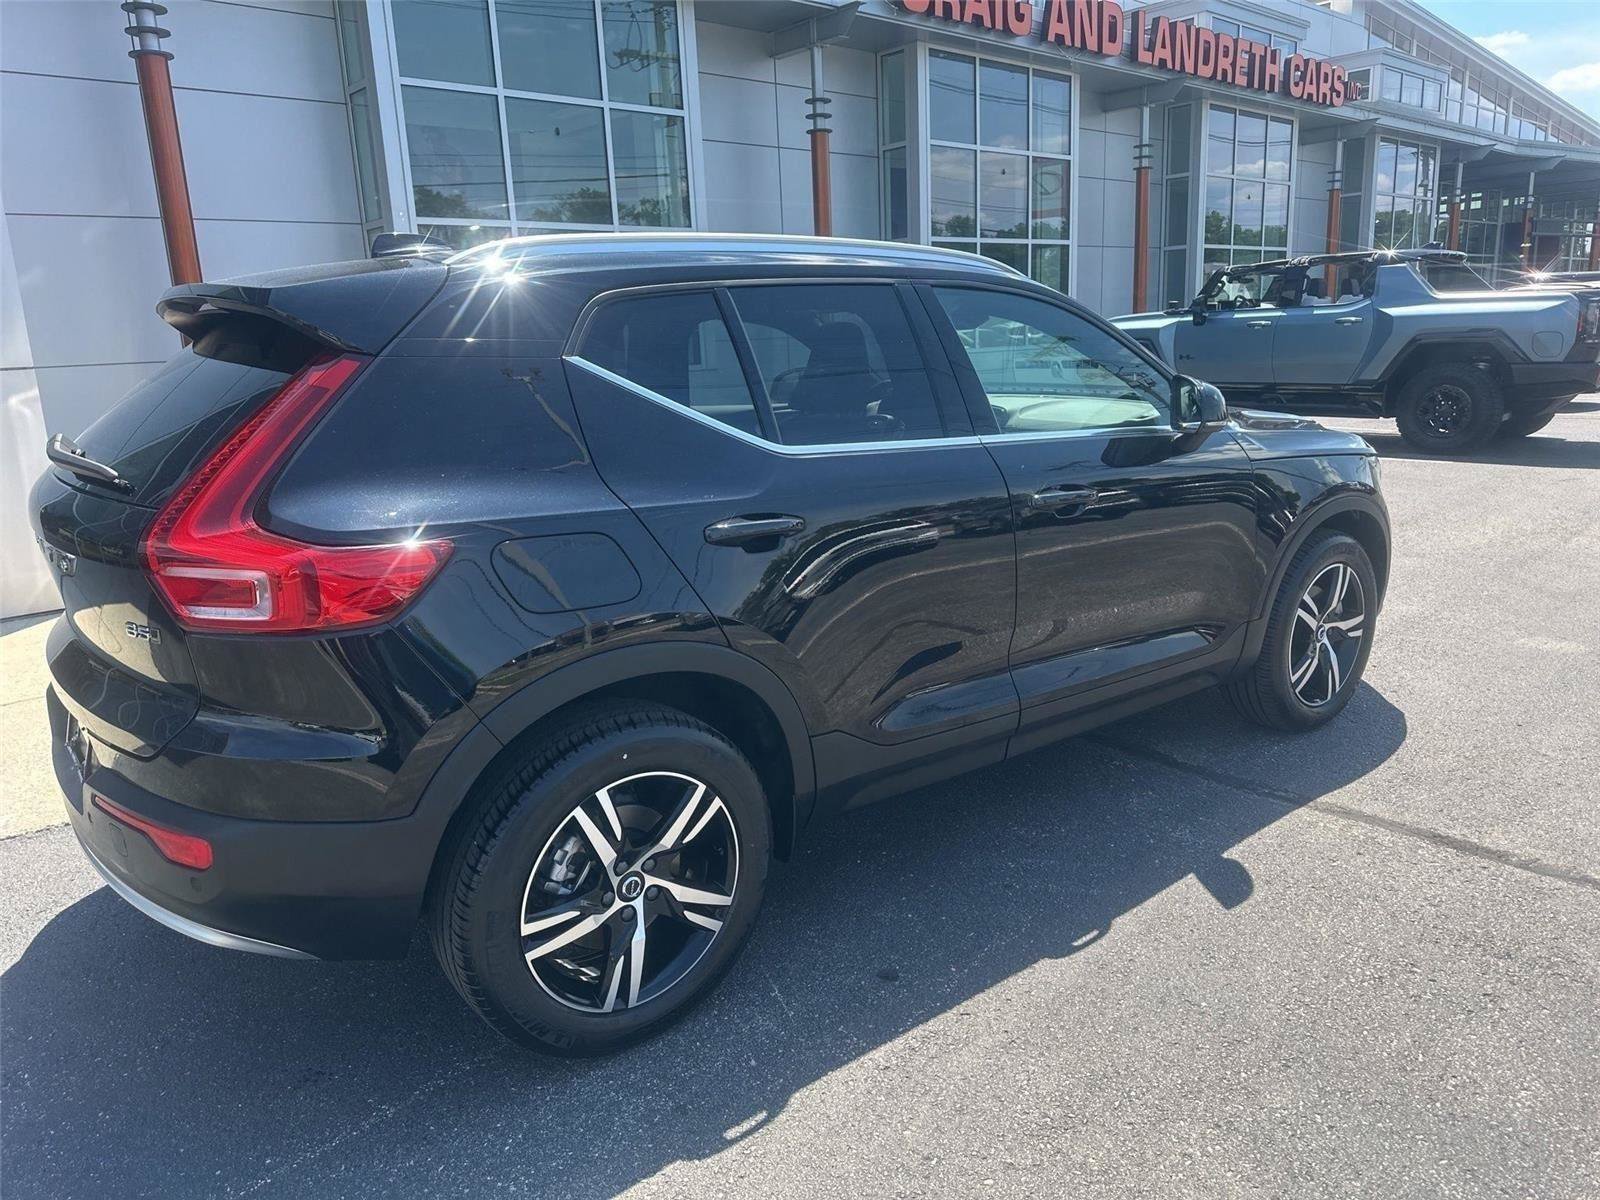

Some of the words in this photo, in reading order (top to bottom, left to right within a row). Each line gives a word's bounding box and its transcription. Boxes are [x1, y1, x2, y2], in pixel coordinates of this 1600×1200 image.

[1045, 0, 1123, 56] AND
[1135, 10, 1280, 93] LANDRETH
[1289, 53, 1345, 107] CARS
